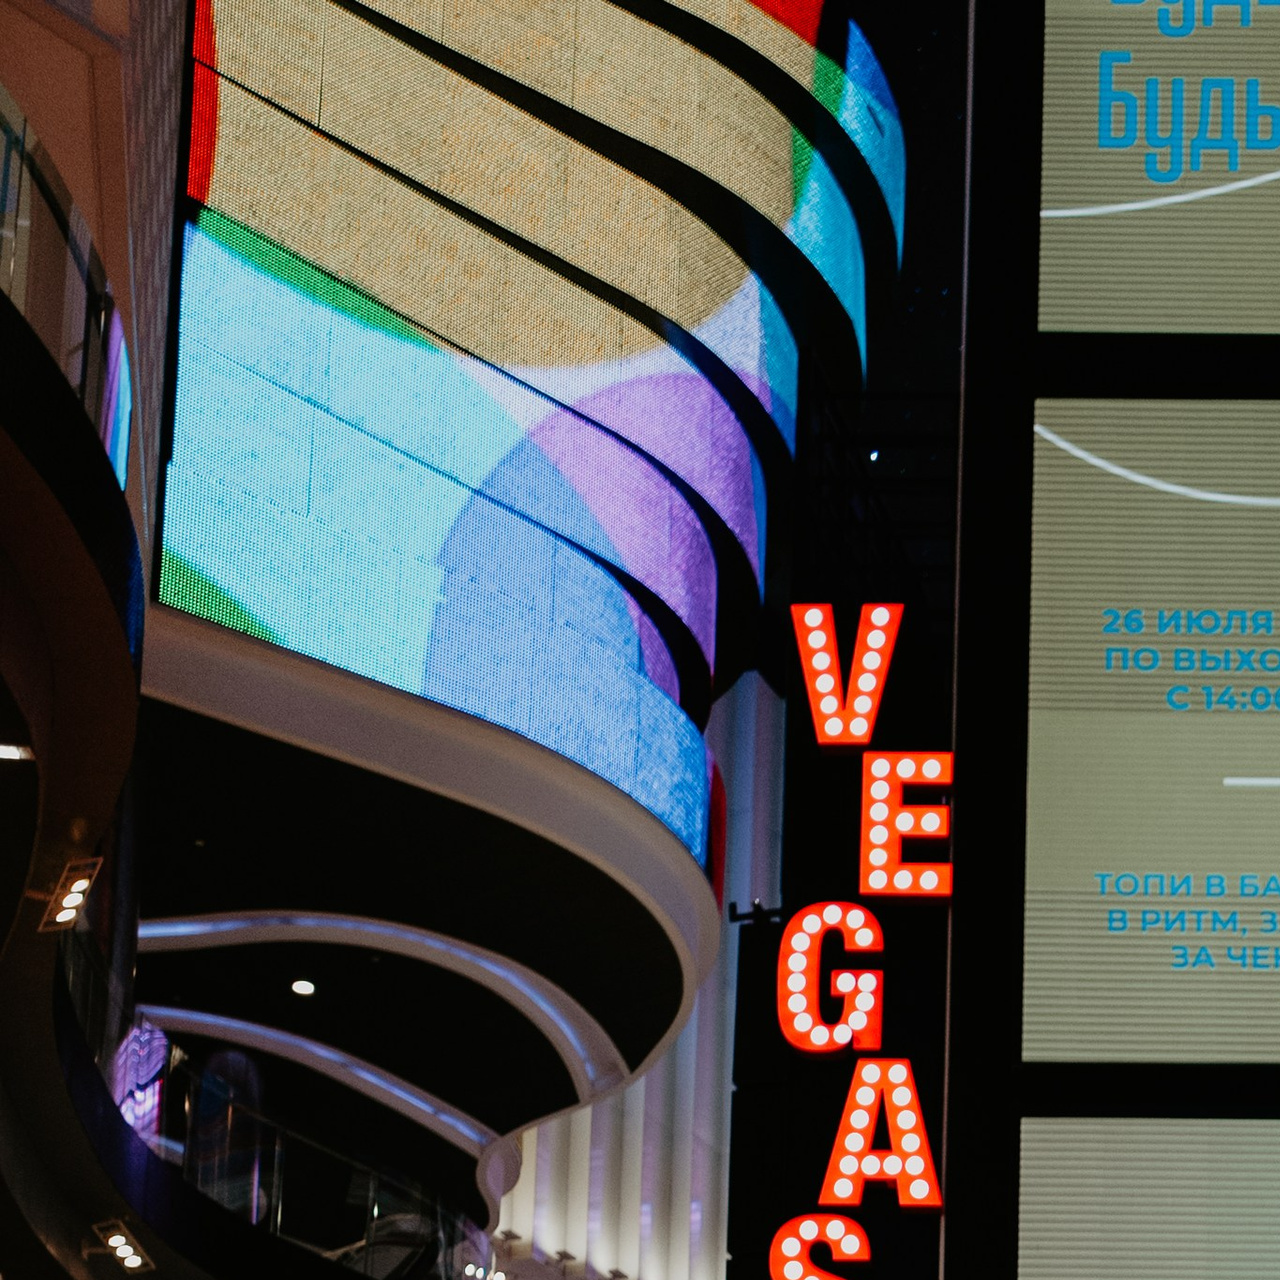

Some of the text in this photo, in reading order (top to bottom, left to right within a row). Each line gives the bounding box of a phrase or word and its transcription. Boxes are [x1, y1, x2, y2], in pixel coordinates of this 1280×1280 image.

[1102, 608, 1144, 635] 26
[1157, 609, 1273, 636] ИЮЛЯ
[1104, 647, 1160, 673] ПО
[1166, 686, 1190, 712] С
[1094, 872, 1193, 898] ТОПИ
[1206, 873, 1226, 898] В
[1107, 910, 1128, 933] В
[1140, 910, 1248, 938] РИТМ,
[1170, 946, 1214, 970] ЗА
